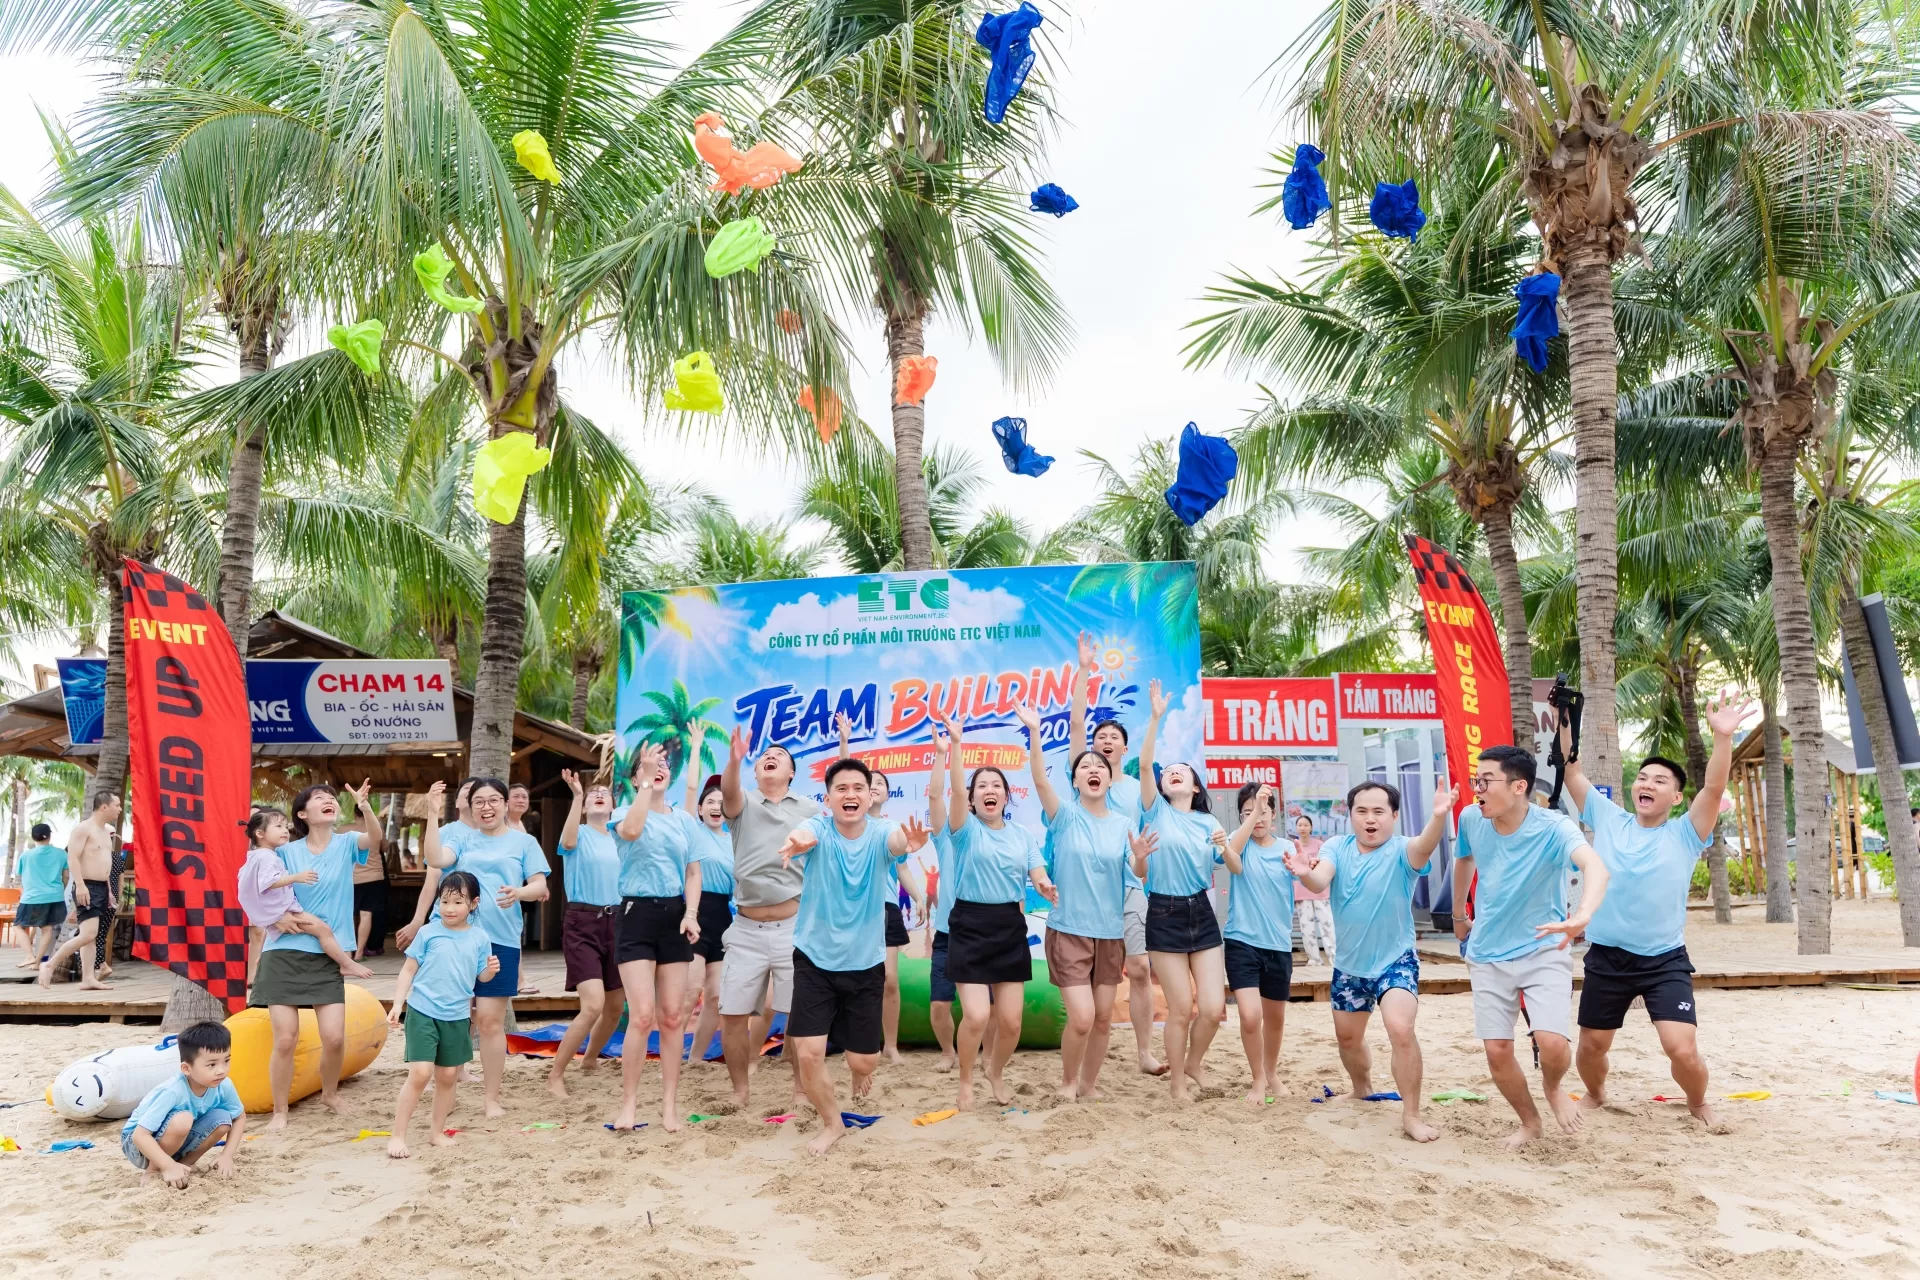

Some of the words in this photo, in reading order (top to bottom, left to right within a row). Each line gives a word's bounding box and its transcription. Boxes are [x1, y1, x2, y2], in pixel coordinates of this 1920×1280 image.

[857, 578, 949, 613] ETC
[129, 618, 208, 646] EVENT
[873, 614, 888, 622] NAM
[768, 632, 802, 649] CÔNG
[805, 634, 819, 648] TY
[823, 628, 840, 646] CỔ
[843, 628, 875, 645] PHẦN
[880, 627, 903, 644] MÔI
[907, 626, 956, 643] TRƯỜNG
[960, 628, 981, 641] ETC
[985, 624, 1012, 643] VIỆT
[1014, 624, 1041, 639] NAM
[155, 655, 204, 719] UP
[317, 673, 406, 699] CHẠM
[413, 674, 445, 693] 14
[1454, 640, 1480, 715] RACE
[324, 703, 346, 712] BIA
[359, 699, 380, 712] ỐC
[392, 700, 415, 712] HẢI
[418, 700, 445, 712] SẢN
[1344, 679, 1379, 714] TẮM
[1383, 683, 1437, 714] TRÁNG
[351, 714, 371, 728] ĐỒ
[374, 715, 422, 727] NƯỚNG
[736, 682, 877, 757] TEAM
[1040, 711, 1098, 742] 206
[1224, 690, 1329, 742] TRÁNG
[348, 732, 371, 740] SĐT:
[373, 732, 397, 740] 0902
[878, 751, 912, 770] MÌNH
[922, 751, 950, 766] CHI
[960, 747, 991, 768] HIỆT
[992, 747, 1021, 766] TÌNH
[1222, 763, 1277, 784] TRÁNG
[158, 735, 207, 881] SPEED
